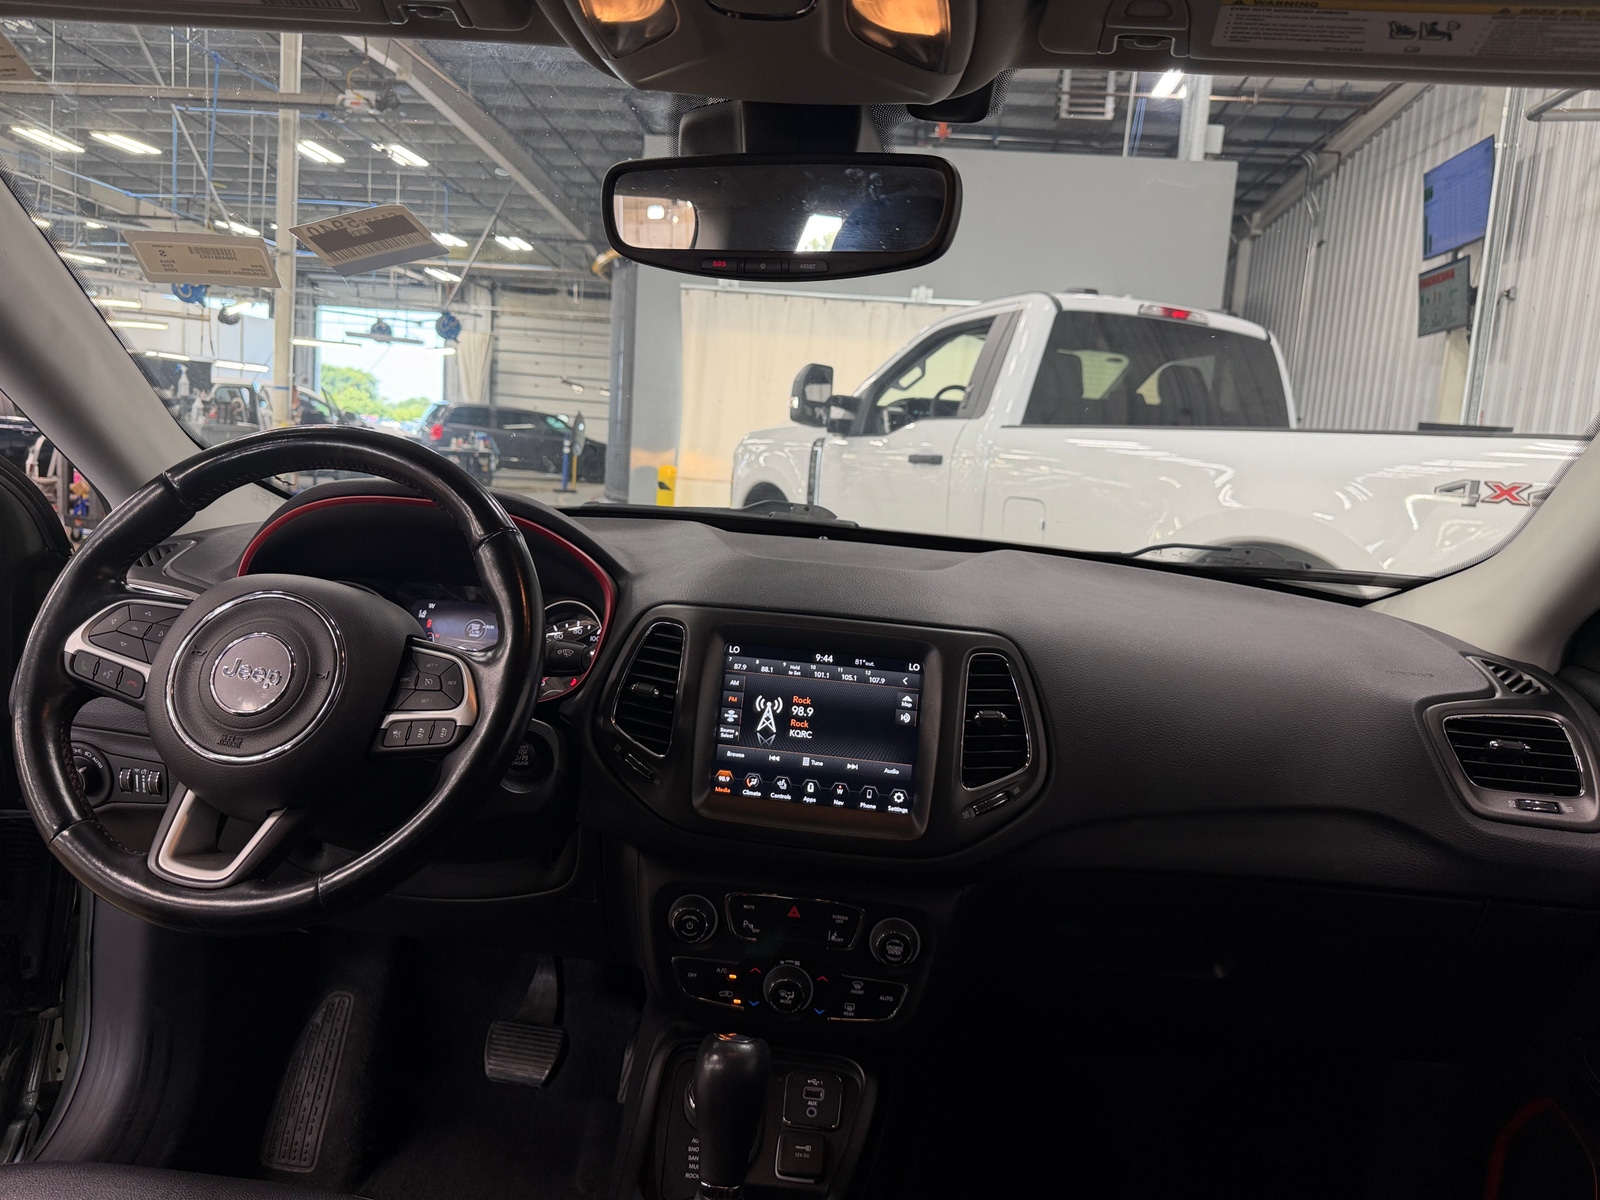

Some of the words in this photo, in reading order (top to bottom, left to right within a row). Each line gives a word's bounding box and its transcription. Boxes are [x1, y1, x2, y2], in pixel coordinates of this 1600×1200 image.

[815, 654, 833, 663] 9:44
[222, 658, 283, 689] Jeep
[869, 676, 886, 684] 107.9
[793, 695, 811, 705] Rock
[791, 705, 814, 716] 98.9
[790, 719, 809, 728] Rock
[789, 729, 813, 739] KQRC
[888, 805, 908, 814] Settings
